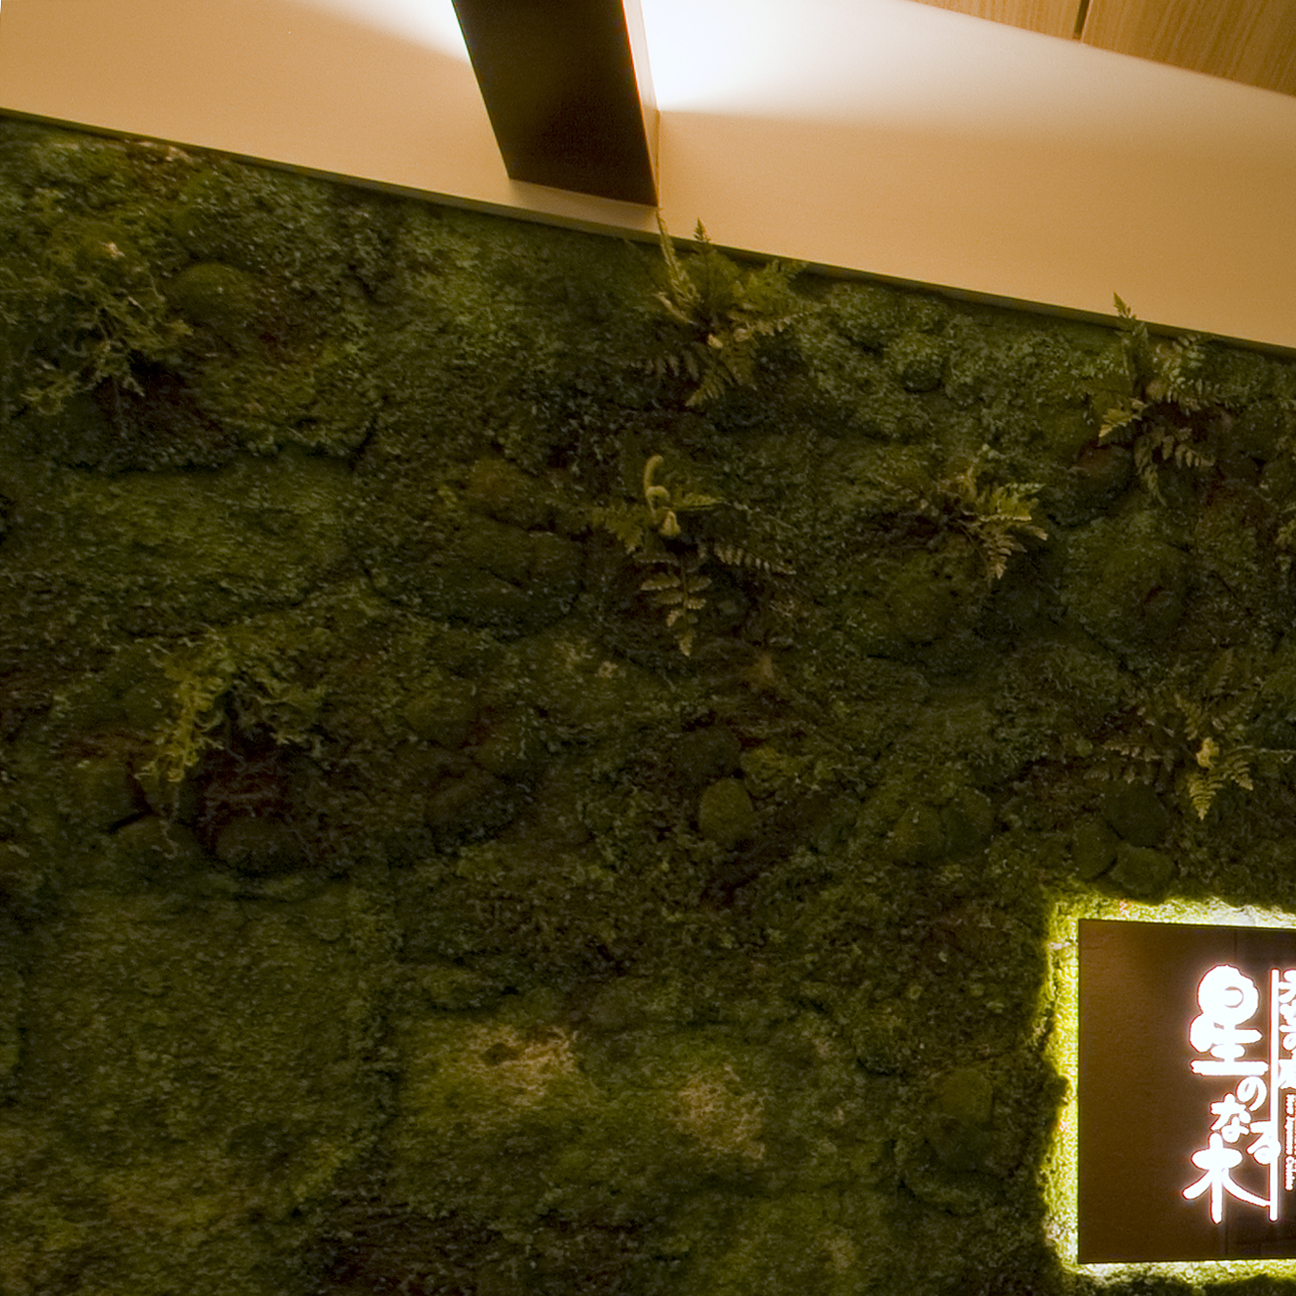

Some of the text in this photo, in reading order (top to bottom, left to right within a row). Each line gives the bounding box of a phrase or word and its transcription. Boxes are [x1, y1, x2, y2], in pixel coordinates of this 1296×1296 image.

[1182, 964, 1281, 1224] 星のなる木
